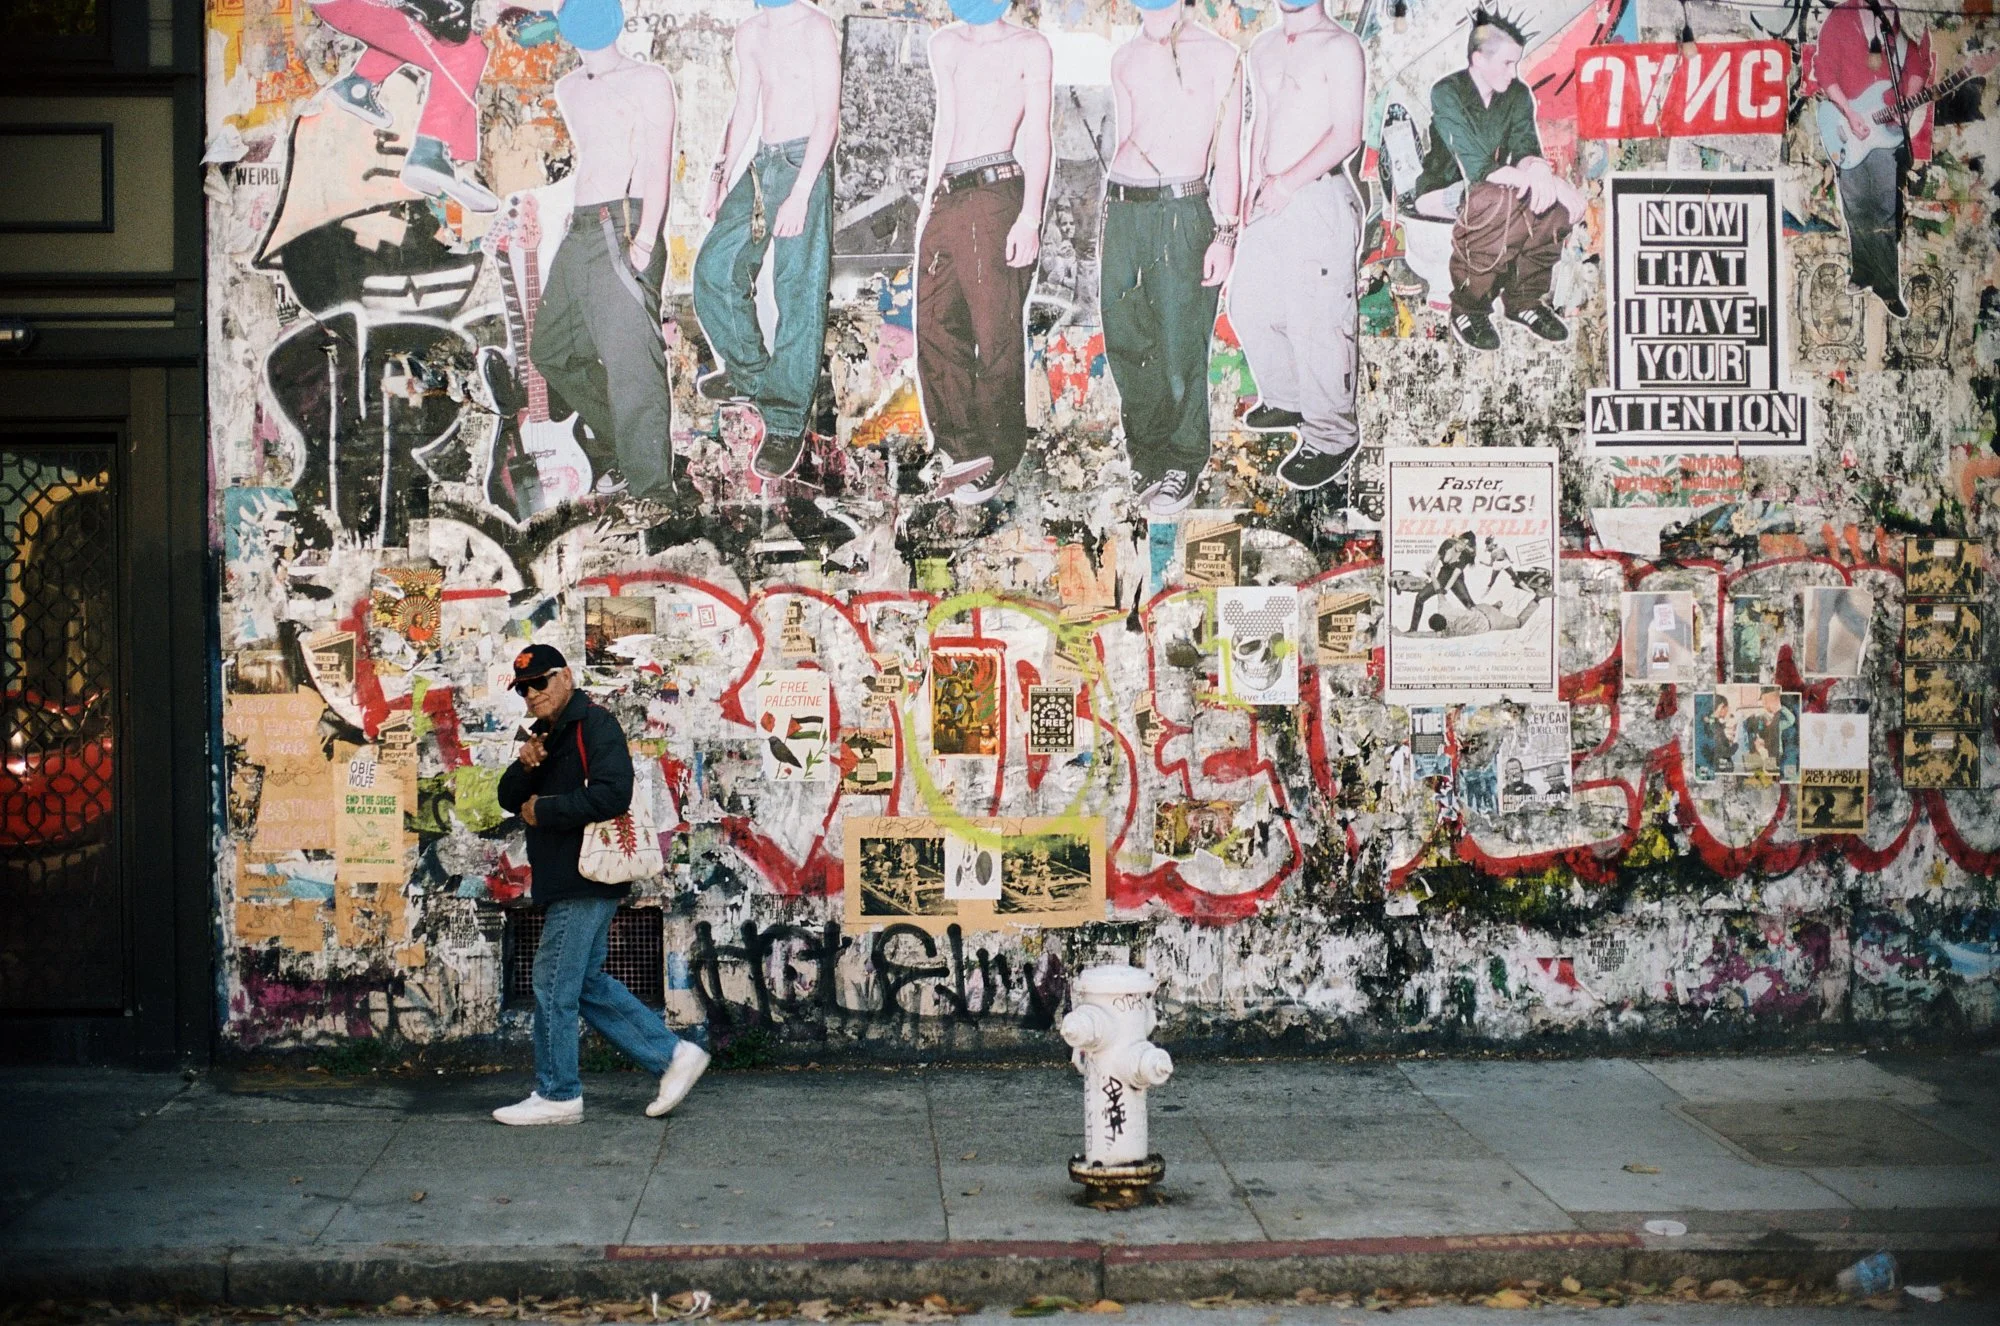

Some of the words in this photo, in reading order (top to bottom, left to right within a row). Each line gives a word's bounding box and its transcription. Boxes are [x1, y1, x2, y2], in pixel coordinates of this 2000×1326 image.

[236, 167, 279, 186] WEIRD
[1647, 202, 1738, 237] NOW
[1640, 251, 1745, 286] THAT
[1661, 299, 1756, 334] HAVE
[1640, 344, 1744, 381] YOUR
[1593, 395, 1797, 432] ATTENTION
[1438, 476, 1504, 492] Faster,
[1408, 495, 1463, 514] WAR
[1471, 495, 1535, 514] PIGS!
[1395, 519, 1470, 536] KILL!
[1474, 519, 1550, 536] KILL!
[779, 681, 809, 693] FREE
[764, 695, 823, 708] PALESTINE
[1039, 719, 1066, 727] FREE
[1549, 711, 1568, 724] CAN
[350, 761, 376, 777] OBIE
[1805, 776, 1824, 784] ACT
[1828, 776, 1837, 784] IT
[1841, 775, 1863, 784] OUT
[346, 795, 360, 804] END
[361, 795, 376, 805] THE
[376, 795, 397, 806] SIEGE
[346, 806, 356, 814] ON
[356, 806, 377, 815] GAZA
[378, 806, 396, 815] NOW
